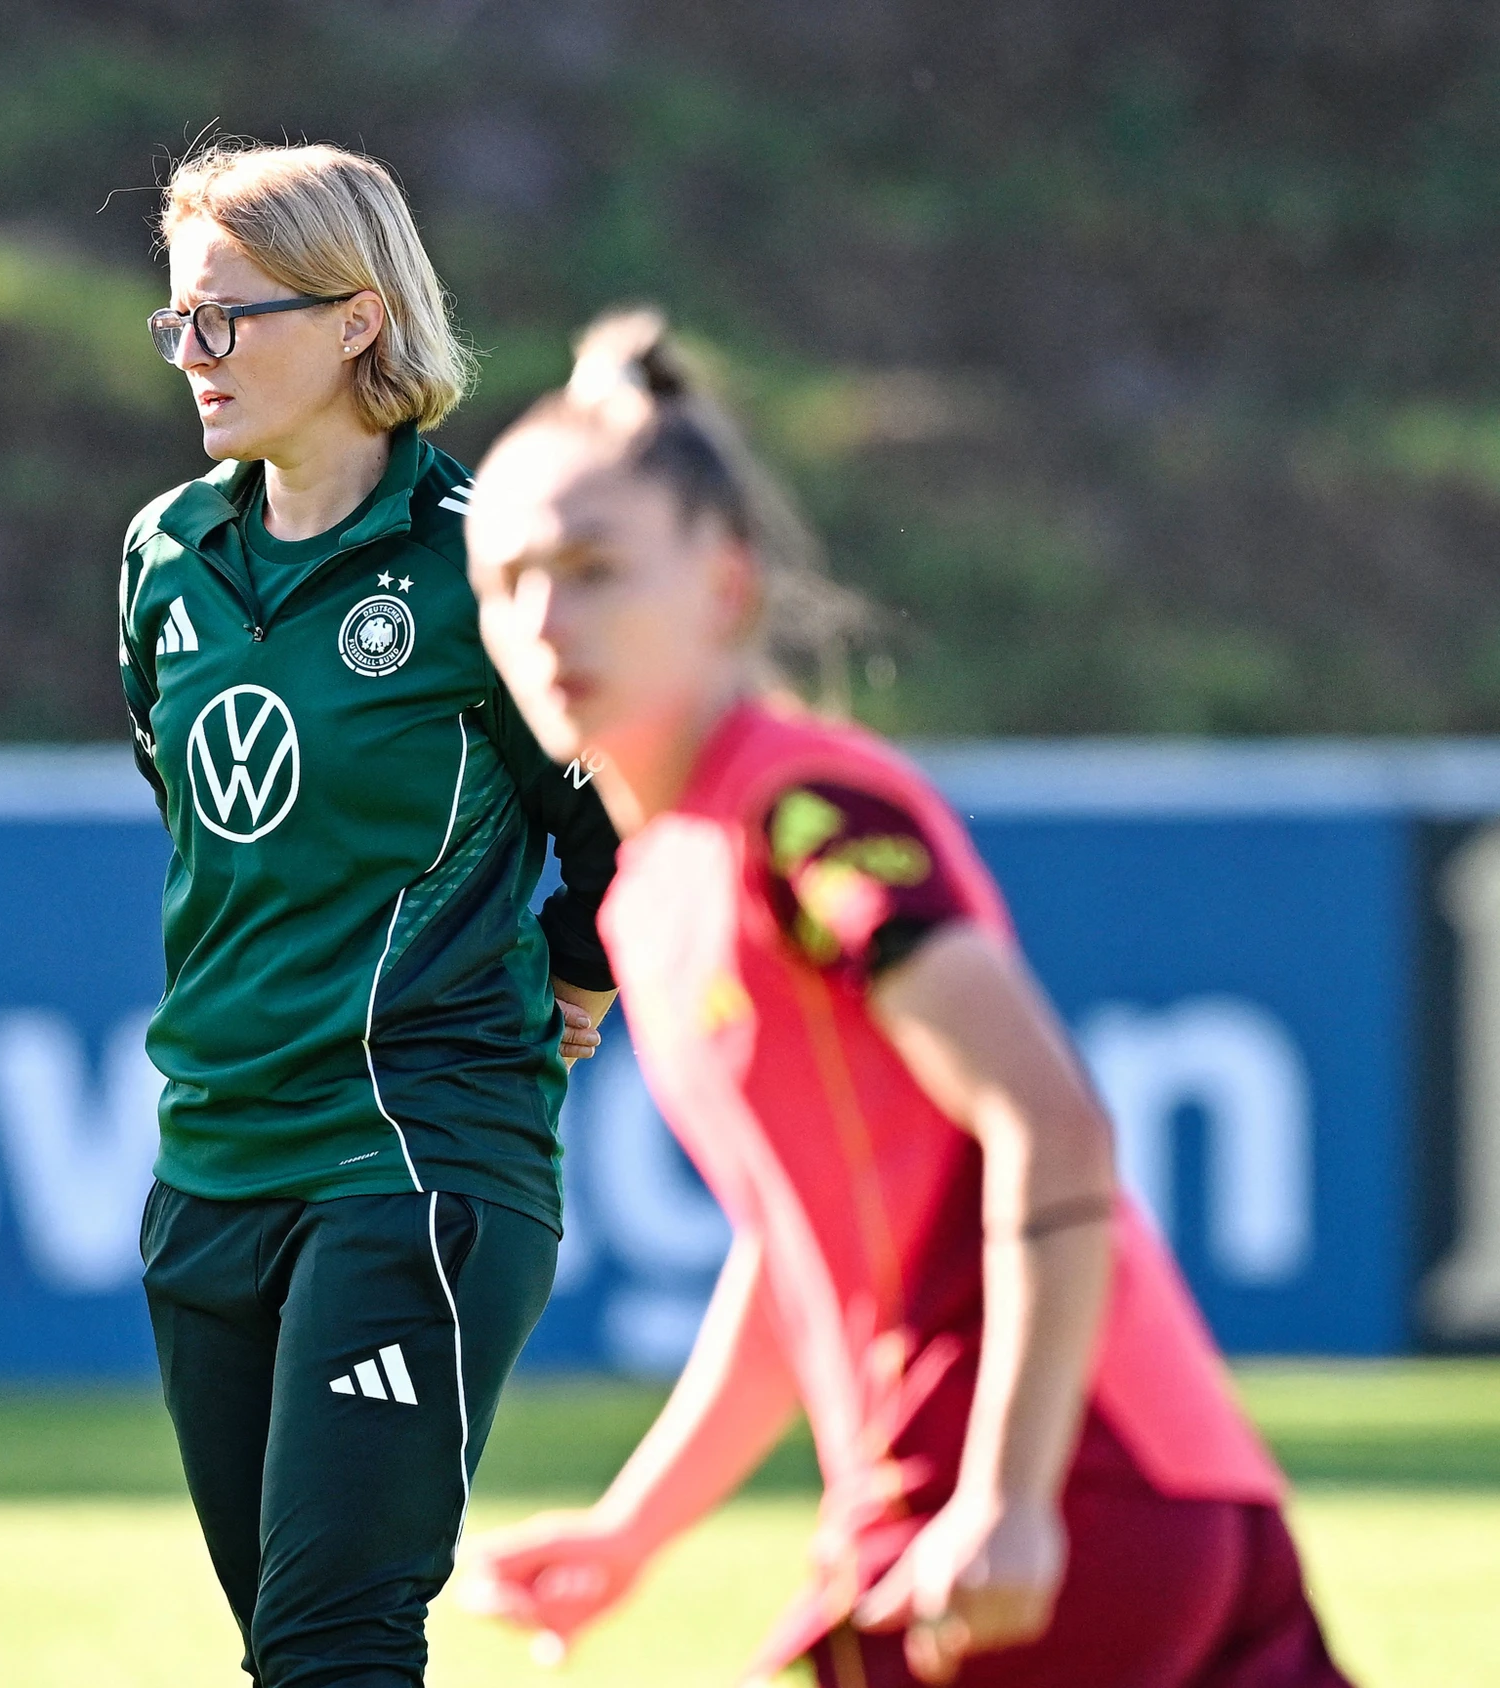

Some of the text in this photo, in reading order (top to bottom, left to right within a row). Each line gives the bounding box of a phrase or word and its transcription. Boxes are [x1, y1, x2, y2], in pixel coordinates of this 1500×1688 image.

[362, 604, 402, 624] DEUTSCHER
[348, 638, 401, 667] FUSSBALL-BUND
[186, 683, 301, 843] VW
